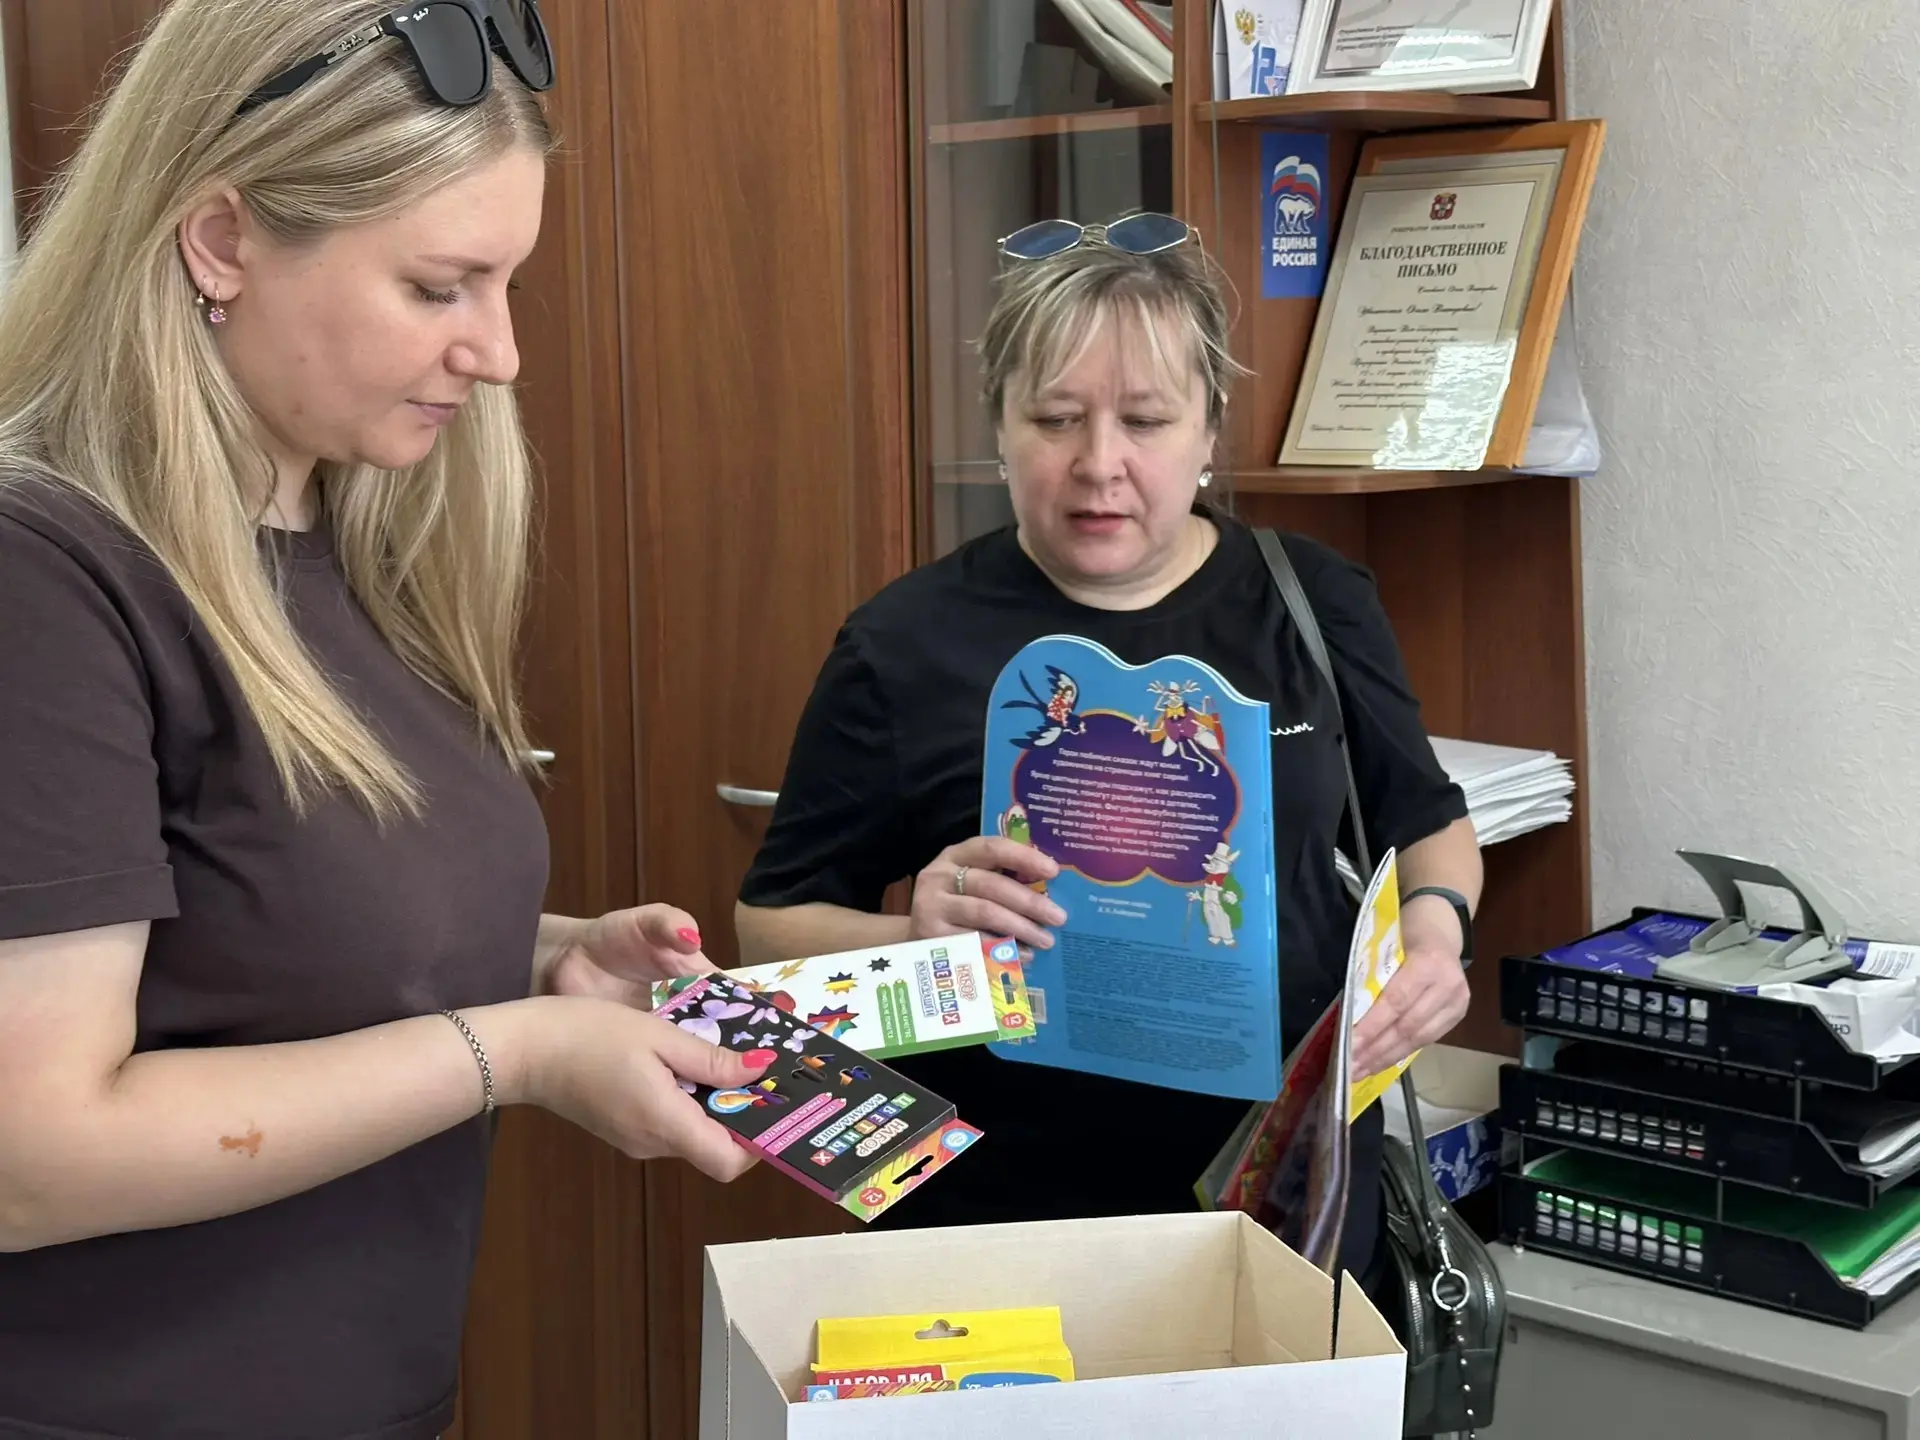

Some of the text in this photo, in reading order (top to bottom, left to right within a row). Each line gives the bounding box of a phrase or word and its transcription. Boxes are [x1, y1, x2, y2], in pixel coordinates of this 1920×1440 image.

[1272, 236, 1317, 252] ЕДИНАЯ
[1360, 241, 1508, 261] БЛАГОДАРСТВЕННОЕ
[1272, 252, 1317, 267] РОССИЯ
[1397, 262, 1458, 278] ПИСЬМО
[915, 958, 939, 1018] КАРАНДАШЕЙ
[930, 947, 961, 1026] ЦВЕТНЫХ
[955, 963, 978, 1002] НАБОР
[1010, 1013, 1022, 1025] 12
[809, 1093, 888, 1148] КАРАНДАШЕЙ
[810, 1092, 917, 1167] ЦВЕТНЫХ
[856, 1118, 909, 1157] НАБОР
[865, 1191, 883, 1204] 12
